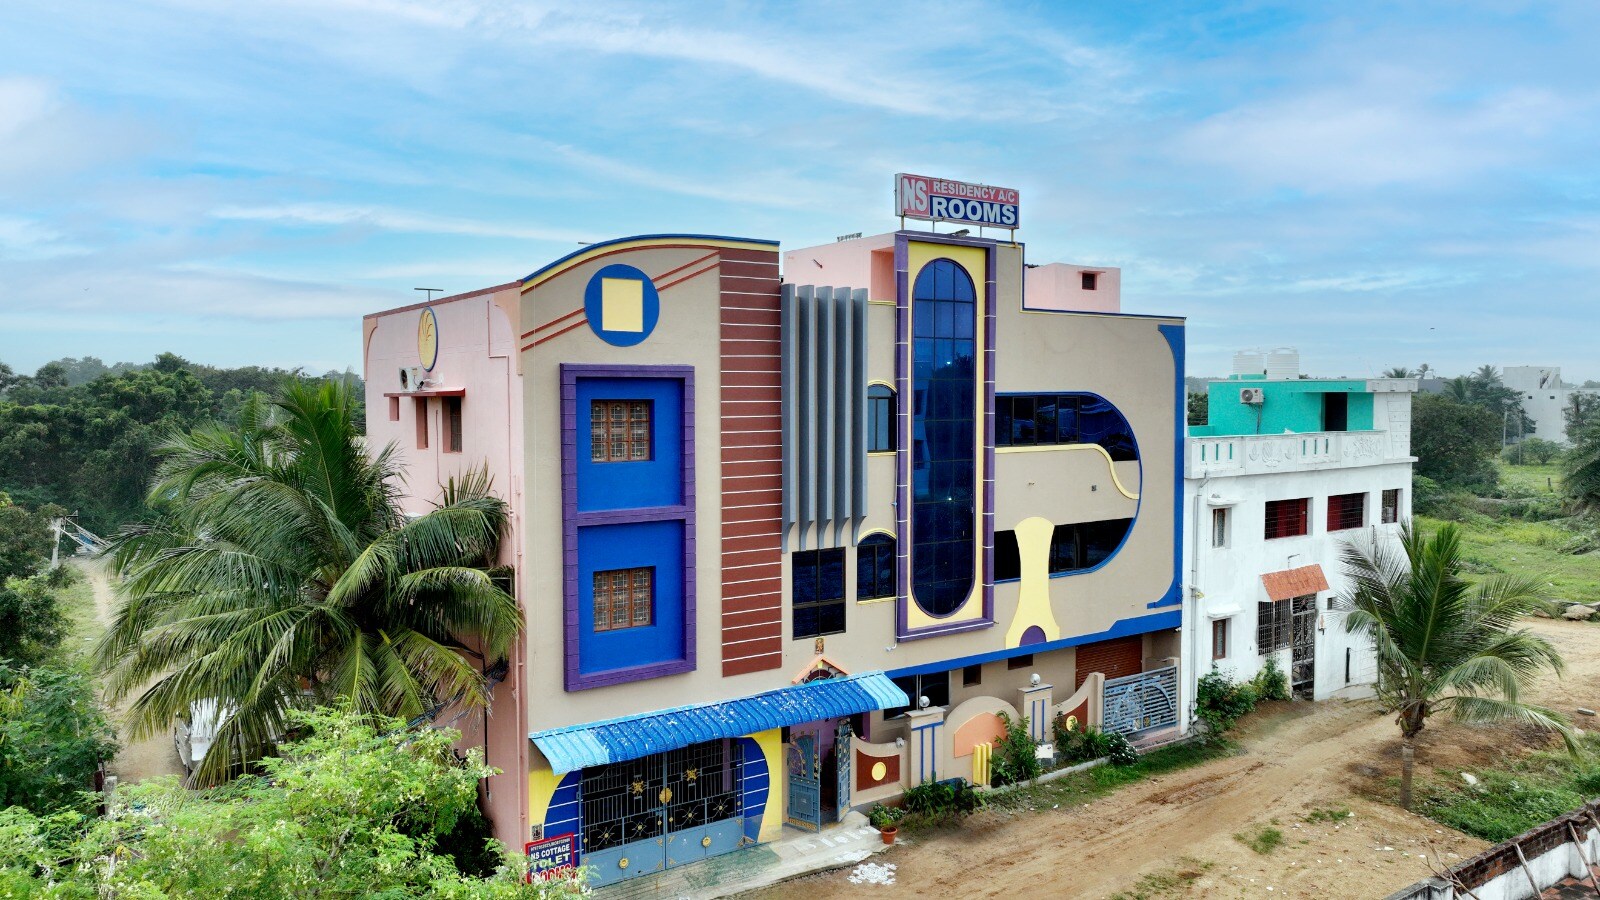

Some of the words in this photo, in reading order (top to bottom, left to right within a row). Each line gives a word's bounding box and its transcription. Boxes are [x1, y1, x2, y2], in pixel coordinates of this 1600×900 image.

[903, 178, 928, 212] NS
[934, 181, 997, 199] RESIDENCY
[998, 190, 1015, 203] A/C
[932, 197, 1016, 224] ROOMS
[541, 844, 570, 858] COTTAGE
